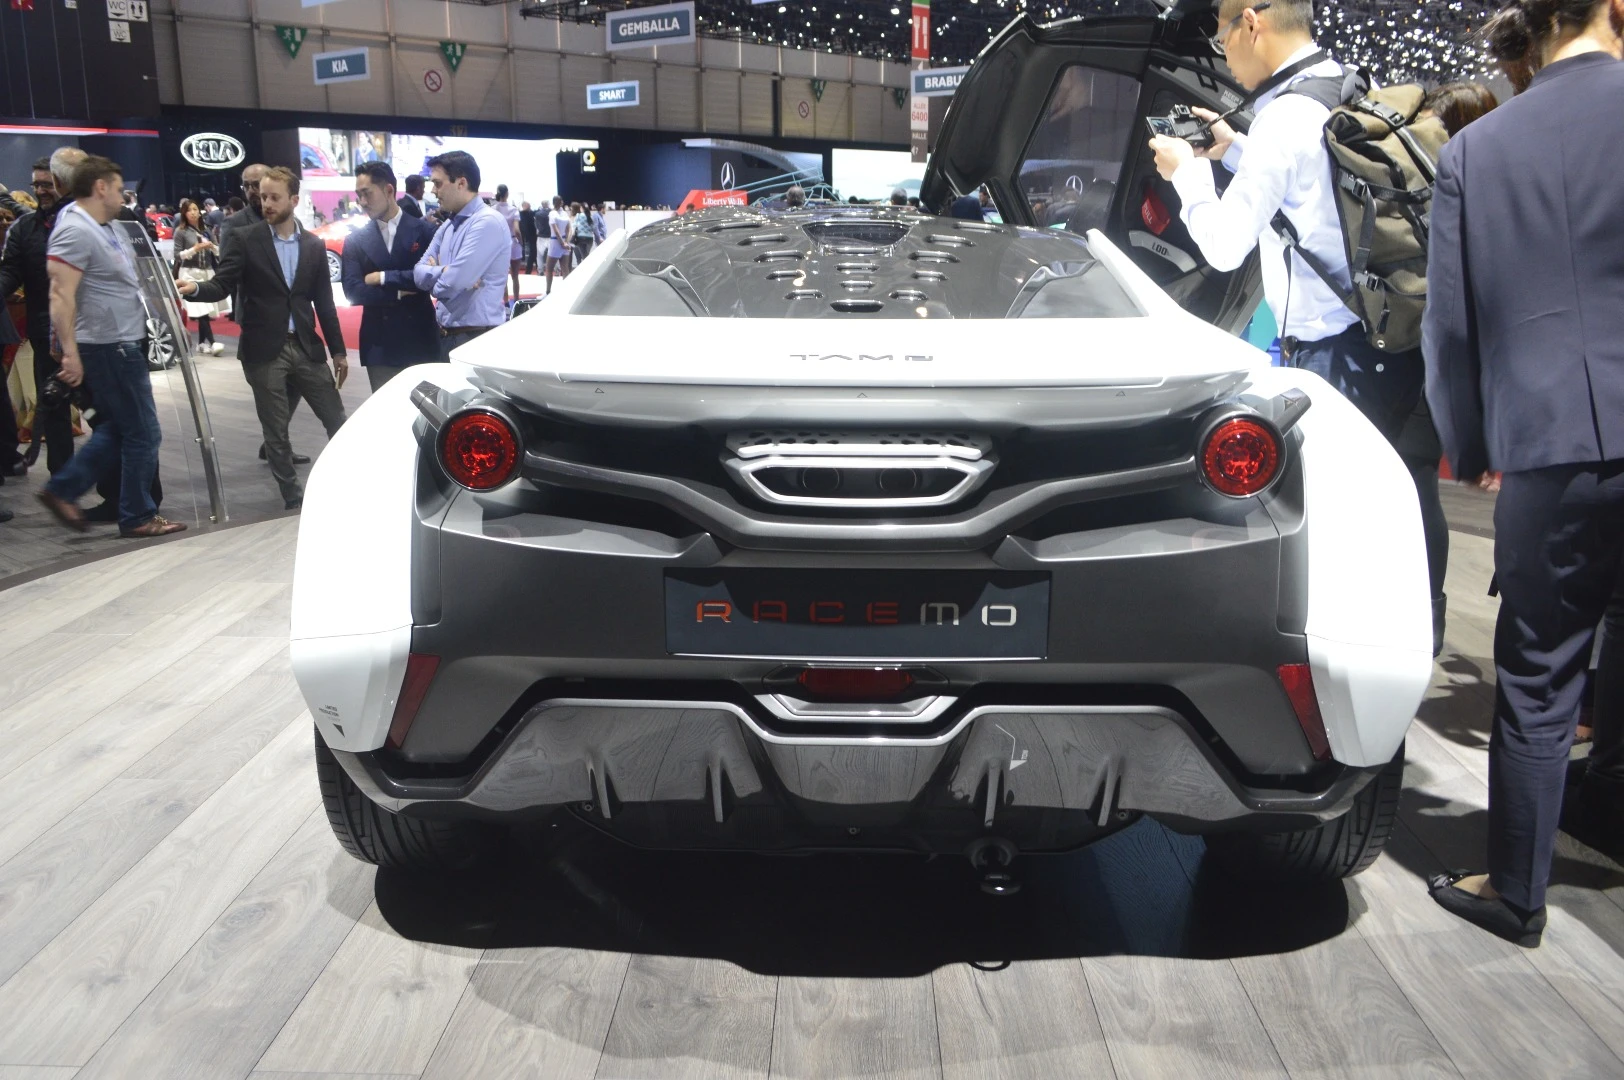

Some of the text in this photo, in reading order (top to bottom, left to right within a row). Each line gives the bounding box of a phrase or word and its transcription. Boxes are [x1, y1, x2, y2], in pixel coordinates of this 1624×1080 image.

[109, 0, 126, 10] WC
[113, 30, 127, 38] WC
[619, 17, 680, 36] GEMBALLA
[331, 59, 349, 74] KIA
[924, 74, 966, 89] BRABU
[599, 89, 626, 101] SMART
[911, 112, 928, 122] 6400
[192, 140, 236, 161] KIA
[696, 600, 1017, 626] RACEMO
